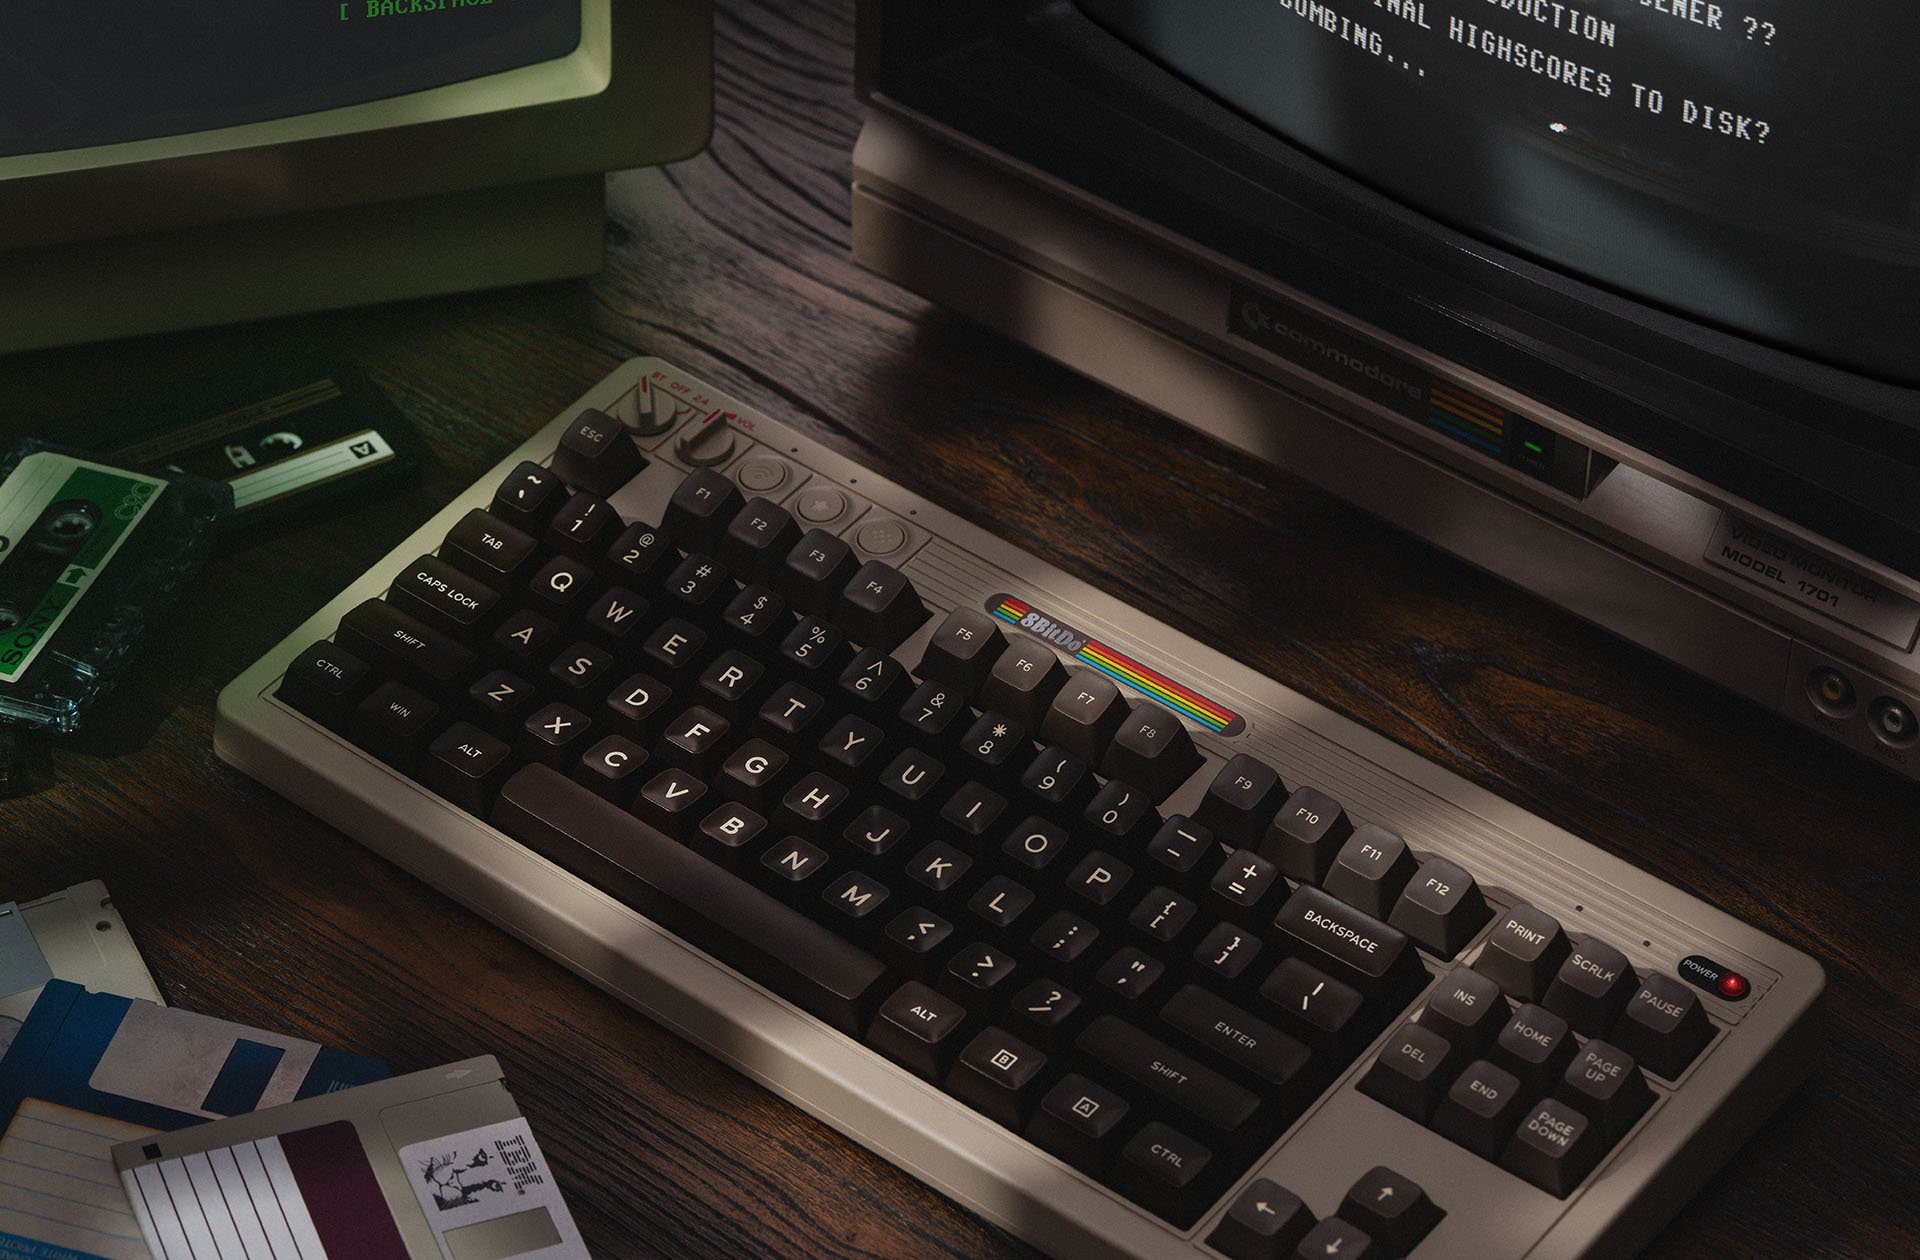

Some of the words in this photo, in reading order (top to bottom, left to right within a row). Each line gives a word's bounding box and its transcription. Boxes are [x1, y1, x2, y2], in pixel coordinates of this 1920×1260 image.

[1743, 15, 1777, 47] ??
[1449, 15, 1612, 98] HIGHSCORES
[1632, 82, 1663, 115] TO
[1682, 99, 1771, 144] DISK?
[1273, 321, 1423, 400] commodore
[670, 381, 692, 394] OFF
[737, 418, 756, 432] VOL
[579, 425, 603, 442] ESC
[527, 475, 542, 485] ~
[695, 487, 711, 500] F1
[584, 503, 596, 517] !
[571, 519, 583, 532] 1
[750, 517, 768, 531] F2
[481, 533, 502, 549] TAB
[638, 533, 655, 548] @
[622, 549, 640, 564] 2
[809, 549, 826, 563] F3
[1731, 523, 1788, 561] VIDEO
[1791, 550, 1879, 604] MONITOR
[695, 564, 712, 578] #
[1721, 545, 1786, 585] MODEL
[1797, 580, 1840, 608] 1701
[550, 571, 573, 592] Q
[680, 580, 697, 594] 3
[866, 580, 883, 594] F4
[416, 571, 447, 592] CAPS
[446, 589, 478, 609] LOCK
[606, 600, 633, 622] W
[753, 596, 768, 610] $
[740, 613, 755, 625] 4
[0, 596, 61, 667] SONY
[393, 630, 425, 648] SHIFT
[510, 627, 533, 644] A
[809, 626, 825, 643] %
[956, 627, 974, 641] F5
[1020, 611, 1083, 652] 8BitDo
[662, 633, 687, 654] E
[795, 643, 813, 658] 5
[316, 659, 342, 678] CTRL
[568, 657, 592, 674] S
[1015, 658, 1034, 672] F6
[718, 665, 743, 687] R
[855, 676, 873, 691] 6
[487, 683, 514, 701] Z
[624, 688, 648, 705] D
[930, 692, 945, 708] &
[1077, 691, 1096, 705] F7
[389, 702, 410, 717] WIN
[783, 697, 805, 717] T
[918, 707, 933, 722] 7
[543, 716, 571, 734] X
[684, 723, 711, 738] F
[1139, 724, 1157, 739] F8
[843, 731, 864, 750] Y
[978, 740, 994, 755] 8
[458, 744, 483, 758] ALT
[604, 751, 627, 766] C
[744, 756, 768, 773] G
[1056, 759, 1067, 773] (
[901, 764, 925, 784] U
[665, 782, 688, 798] V
[1038, 775, 1056, 790] 9
[1234, 776, 1253, 790] F9
[801, 787, 829, 808] H
[1118, 793, 1130, 806] )
[965, 801, 981, 817] I
[1102, 810, 1118, 824] 0
[1295, 807, 1319, 824] F10
[719, 816, 744, 834] B
[865, 828, 890, 843] J
[1024, 834, 1047, 852] O
[780, 850, 808, 870] N
[1360, 844, 1382, 860] F11
[925, 857, 952, 878] K
[1085, 867, 1111, 883] P
[1242, 864, 1257, 879] +
[1228, 881, 1246, 895] =
[1425, 878, 1449, 895] F12
[840, 885, 871, 906] M
[988, 892, 1005, 912] L
[1163, 901, 1177, 915] {
[918, 923, 935, 935] <
[1149, 914, 1165, 929] [
[1304, 910, 1378, 954] BACKSPACE
[1505, 919, 1545, 944] PRINT
[1226, 936, 1241, 951] }
[976, 955, 994, 968] >
[1214, 950, 1229, 965] ]
[1571, 953, 1614, 981] SCRLK
[1683, 959, 1718, 980] POWER
[1045, 990, 1062, 1005] ?
[1452, 988, 1475, 1005] INS
[1638, 989, 1683, 1017] PAUSE
[910, 1005, 936, 1021] ALT
[1214, 1021, 1256, 1048] ENTER
[1512, 1020, 1552, 1046] HOME
[1401, 1043, 1424, 1062] DEL
[1150, 1061, 1187, 1083] SHIFT
[1585, 1052, 1621, 1076] PAGE
[1586, 1068, 1606, 1084] UP
[1469, 1079, 1497, 1099] END
[1538, 1111, 1574, 1136] PAGE
[1530, 1120, 1568, 1146] DOWN
[1150, 1143, 1182, 1167] CTRL
